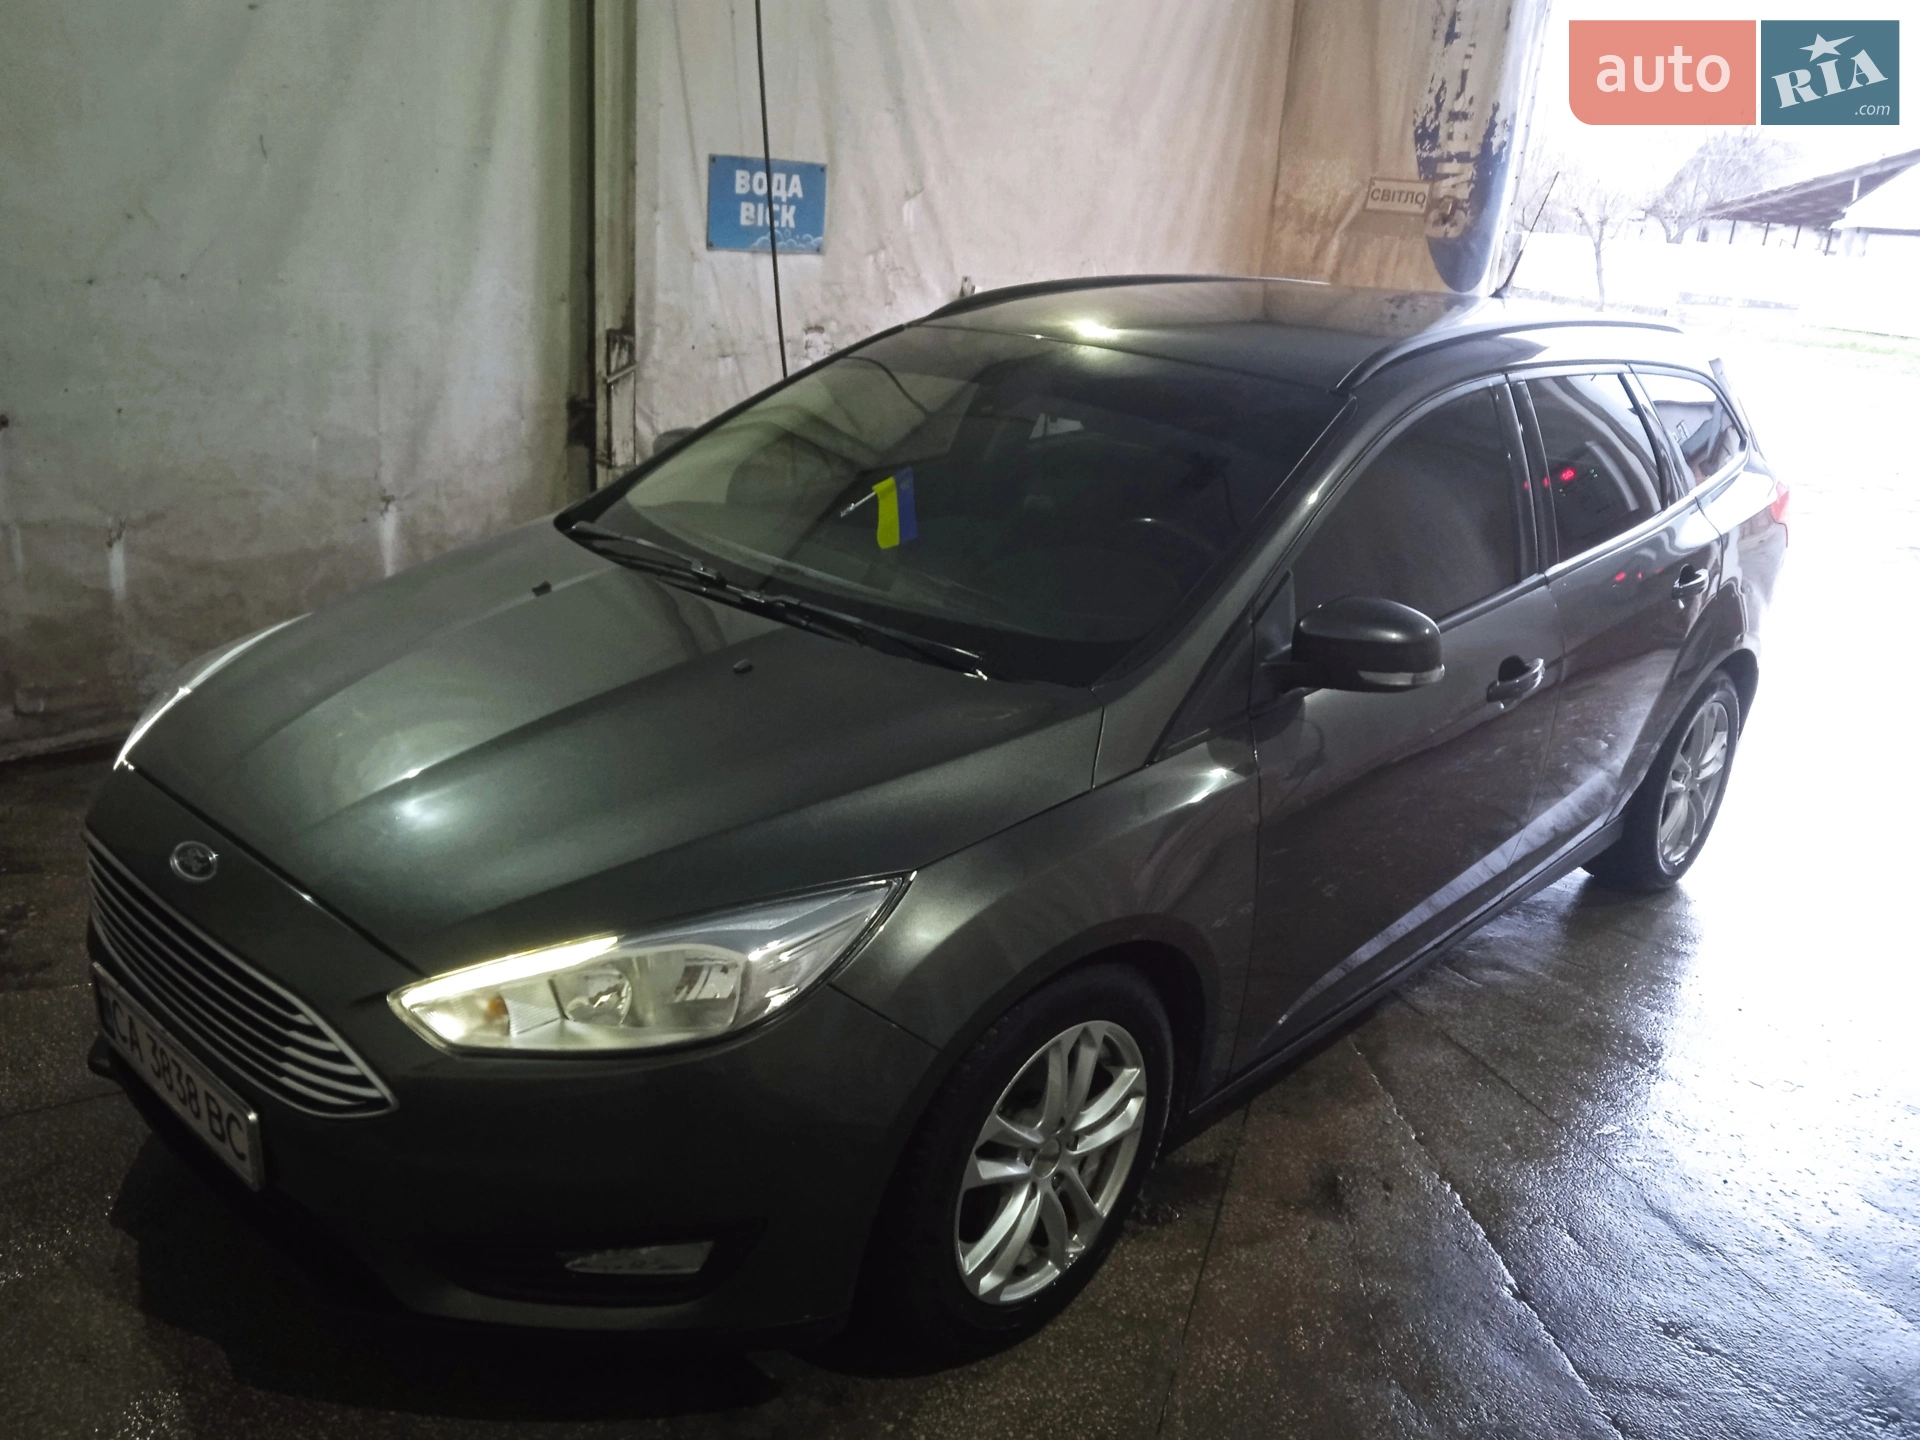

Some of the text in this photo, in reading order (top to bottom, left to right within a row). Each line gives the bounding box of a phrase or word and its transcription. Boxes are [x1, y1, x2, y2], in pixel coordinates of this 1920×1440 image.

[735, 169, 803, 203] ВОДА
[1370, 188, 1427, 205] СВІТЛО
[740, 201, 796, 229] ВІСК
[146, 1031, 201, 1120] 3838
[204, 1090, 246, 1162] BC
